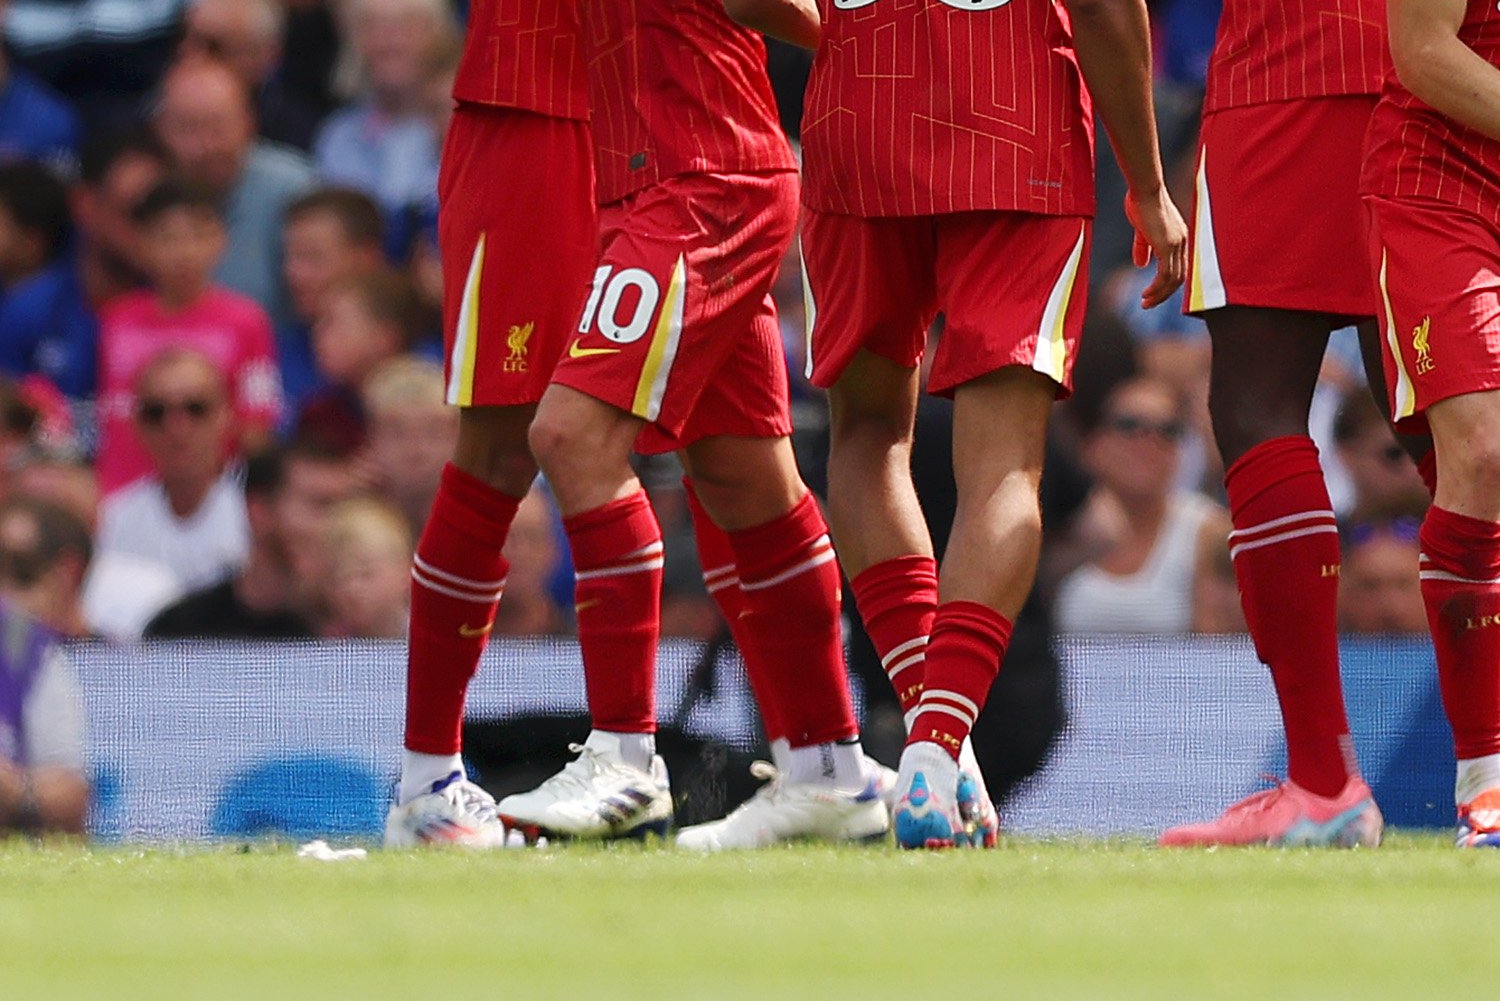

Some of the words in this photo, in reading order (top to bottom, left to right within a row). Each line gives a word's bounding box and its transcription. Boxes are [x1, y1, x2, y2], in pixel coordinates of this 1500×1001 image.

[578, 264, 660, 344] 10
[1416, 359, 1435, 376] LFC
[930, 729, 960, 749] LFC
